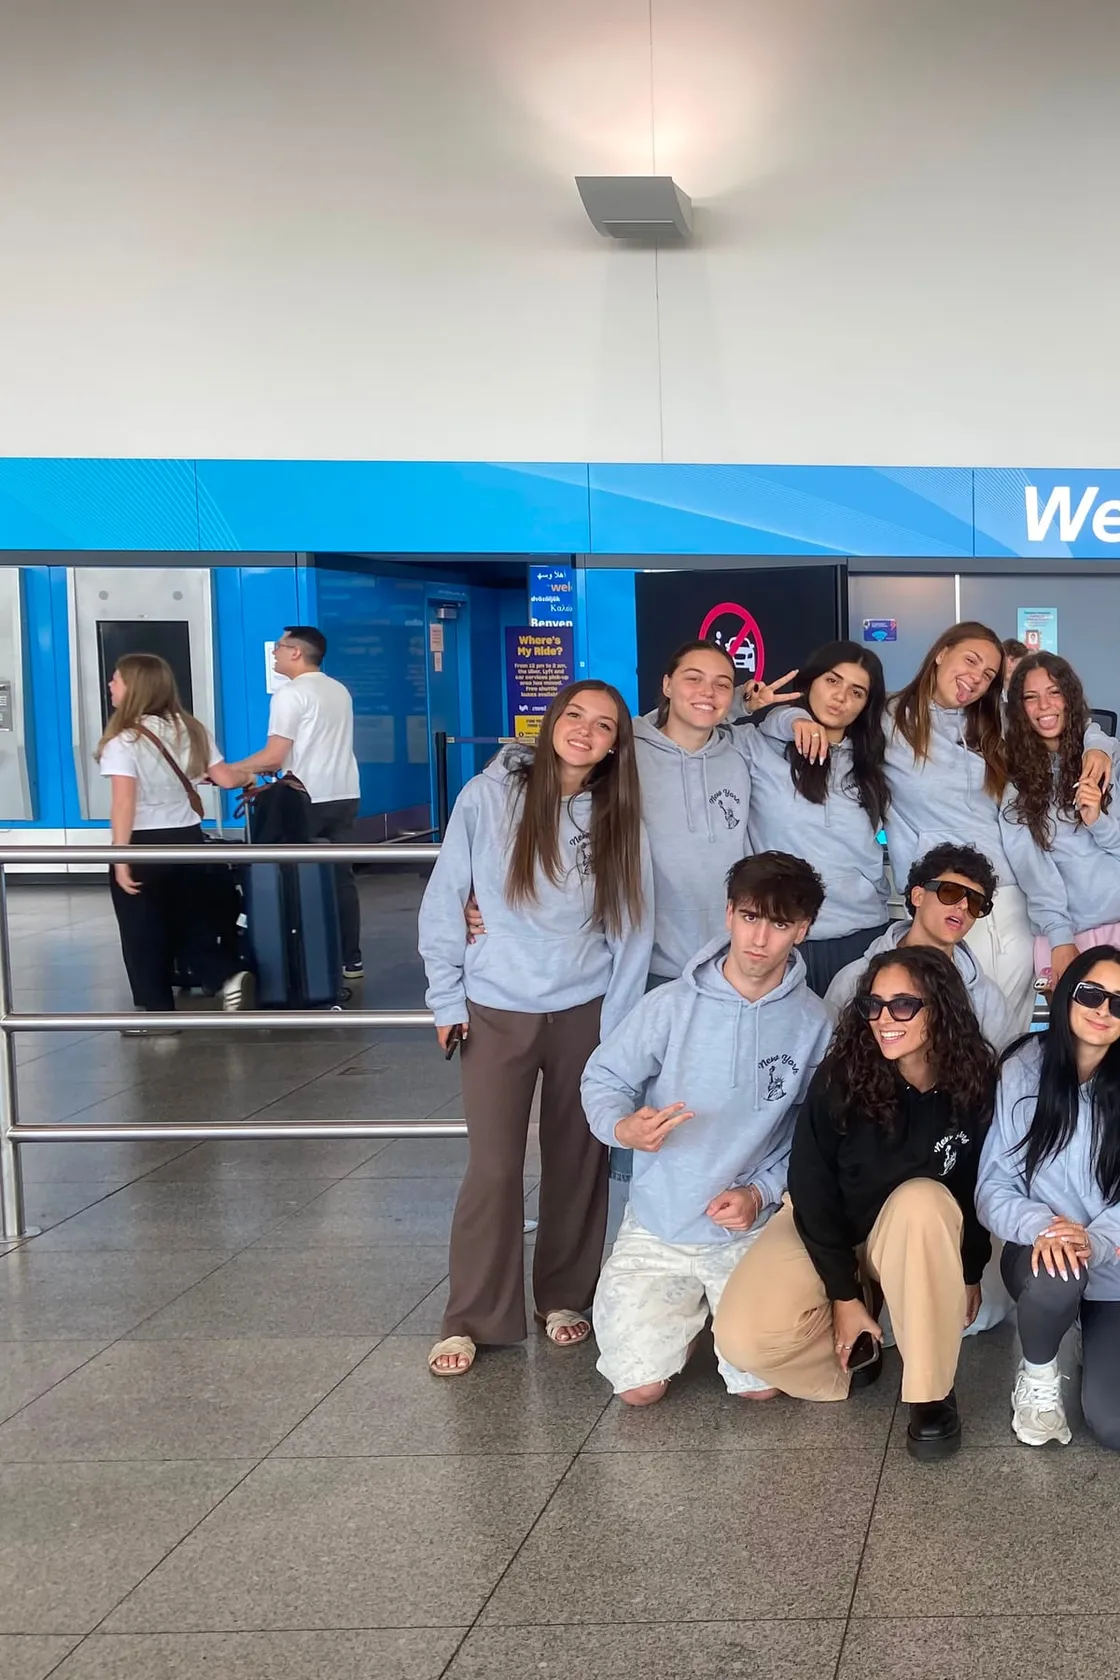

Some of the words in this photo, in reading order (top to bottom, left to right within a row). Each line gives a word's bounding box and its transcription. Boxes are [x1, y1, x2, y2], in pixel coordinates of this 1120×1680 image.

[551, 581, 573, 592] wel
[519, 636, 561, 645] Where's
[517, 646, 532, 658] My
[534, 646, 563, 656] Ride?
[758, 1055, 780, 1069] New
